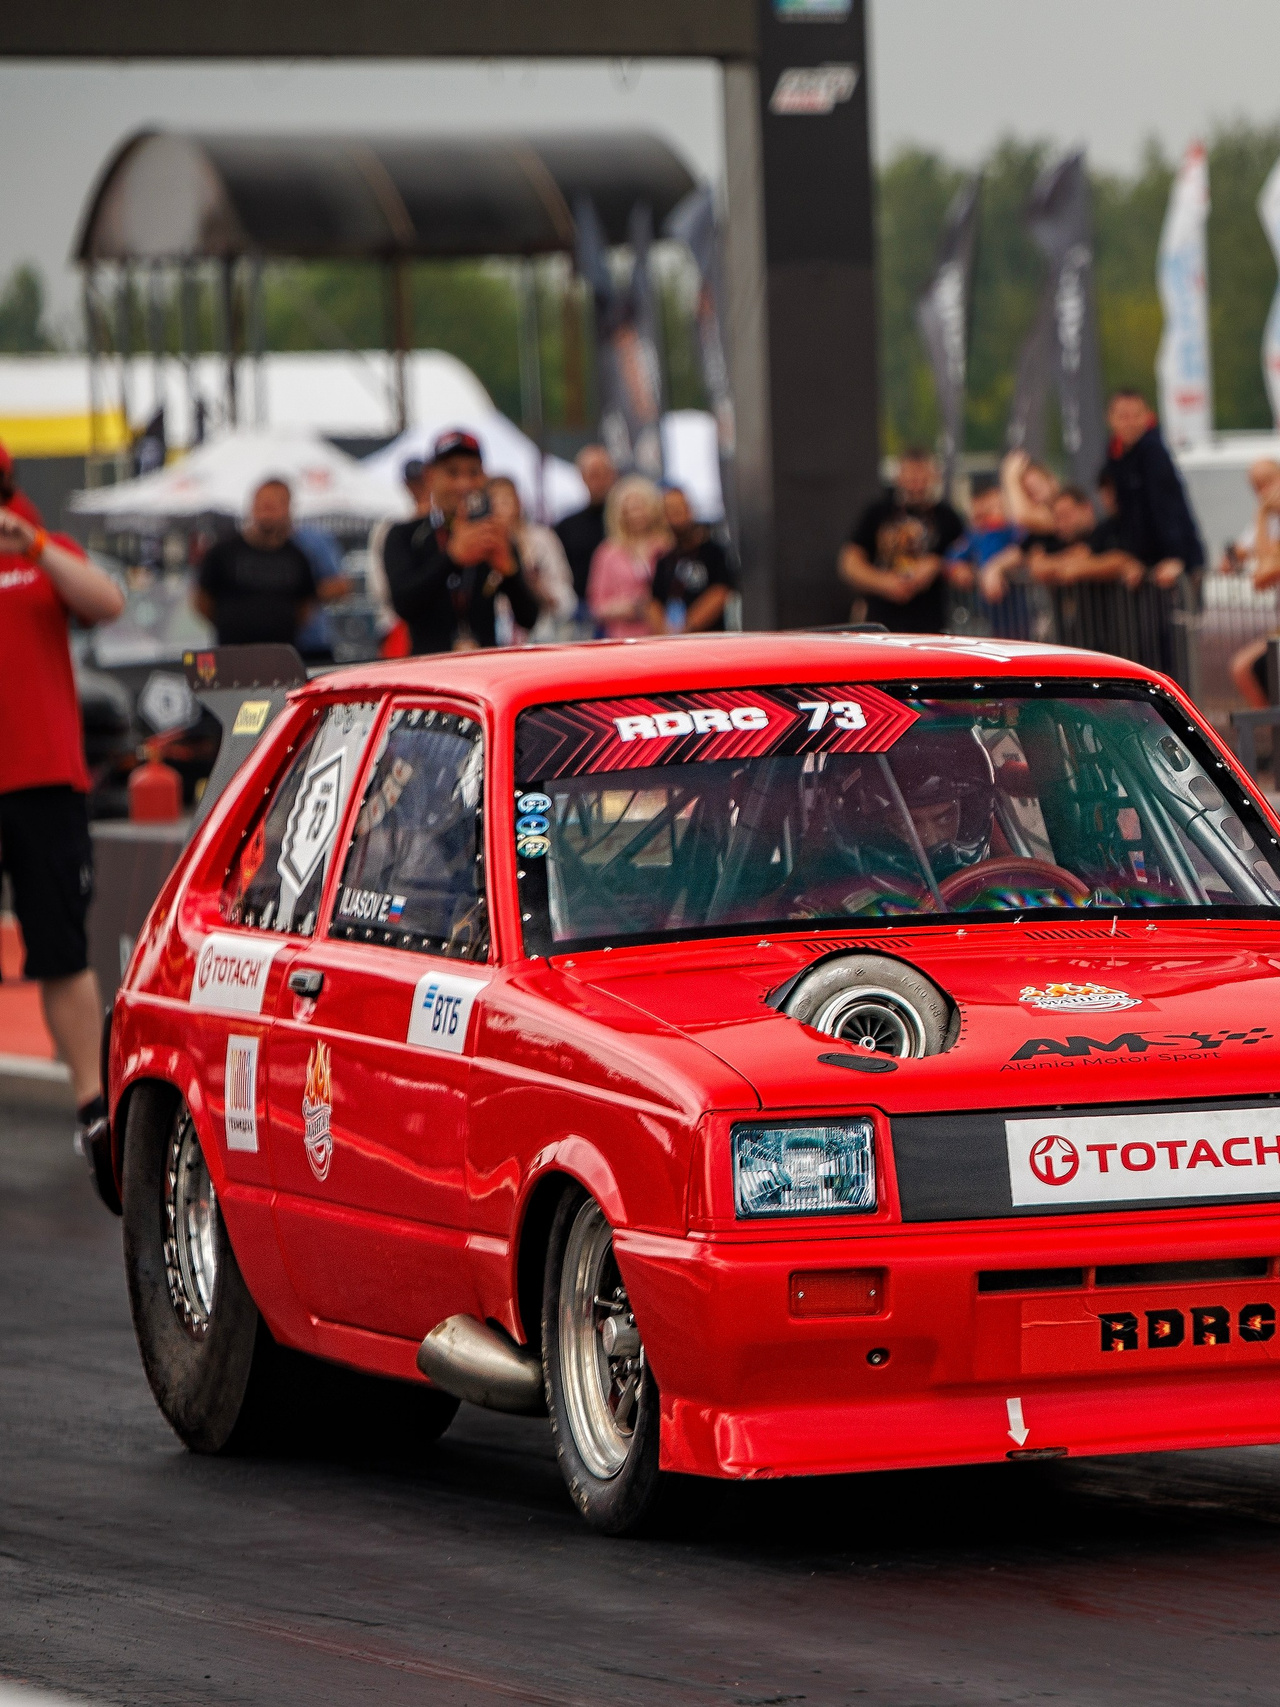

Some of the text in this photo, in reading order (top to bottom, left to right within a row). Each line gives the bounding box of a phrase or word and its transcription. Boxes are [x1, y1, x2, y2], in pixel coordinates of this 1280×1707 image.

[612, 701, 867, 742] RDRC 73
[432, 994, 463, 1035] ВТБ
[1000, 1051, 1222, 1072] Alania Motor Sport
[1098, 1303, 1276, 1352] RDRC
